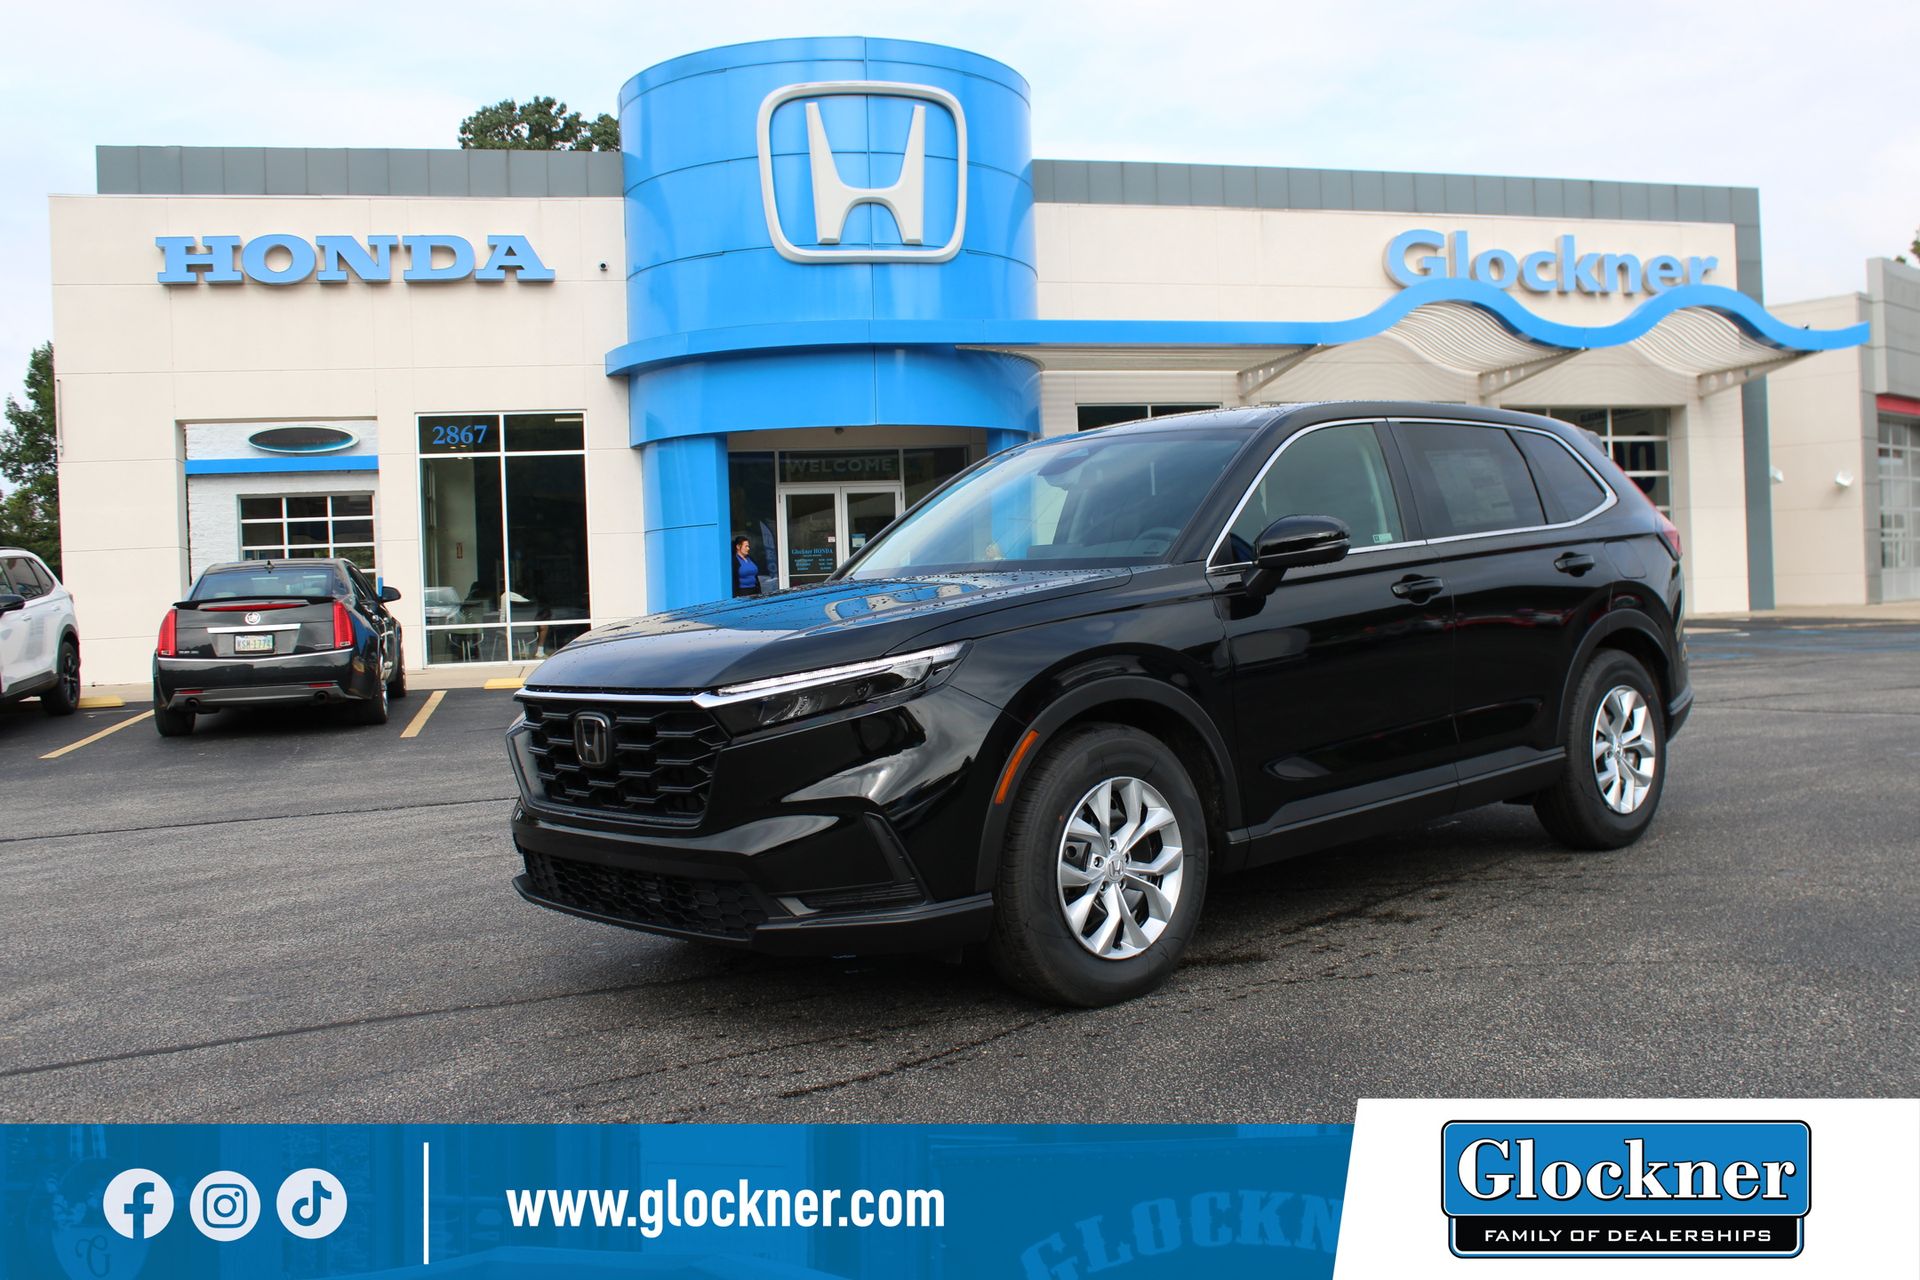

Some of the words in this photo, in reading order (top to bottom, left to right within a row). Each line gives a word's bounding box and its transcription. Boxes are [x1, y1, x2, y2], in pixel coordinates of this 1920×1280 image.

[155, 233, 556, 285] HONDA
[1382, 229, 1719, 297] Glockner
[432, 424, 488, 445] 2867
[785, 458, 893, 473] WELCOME
